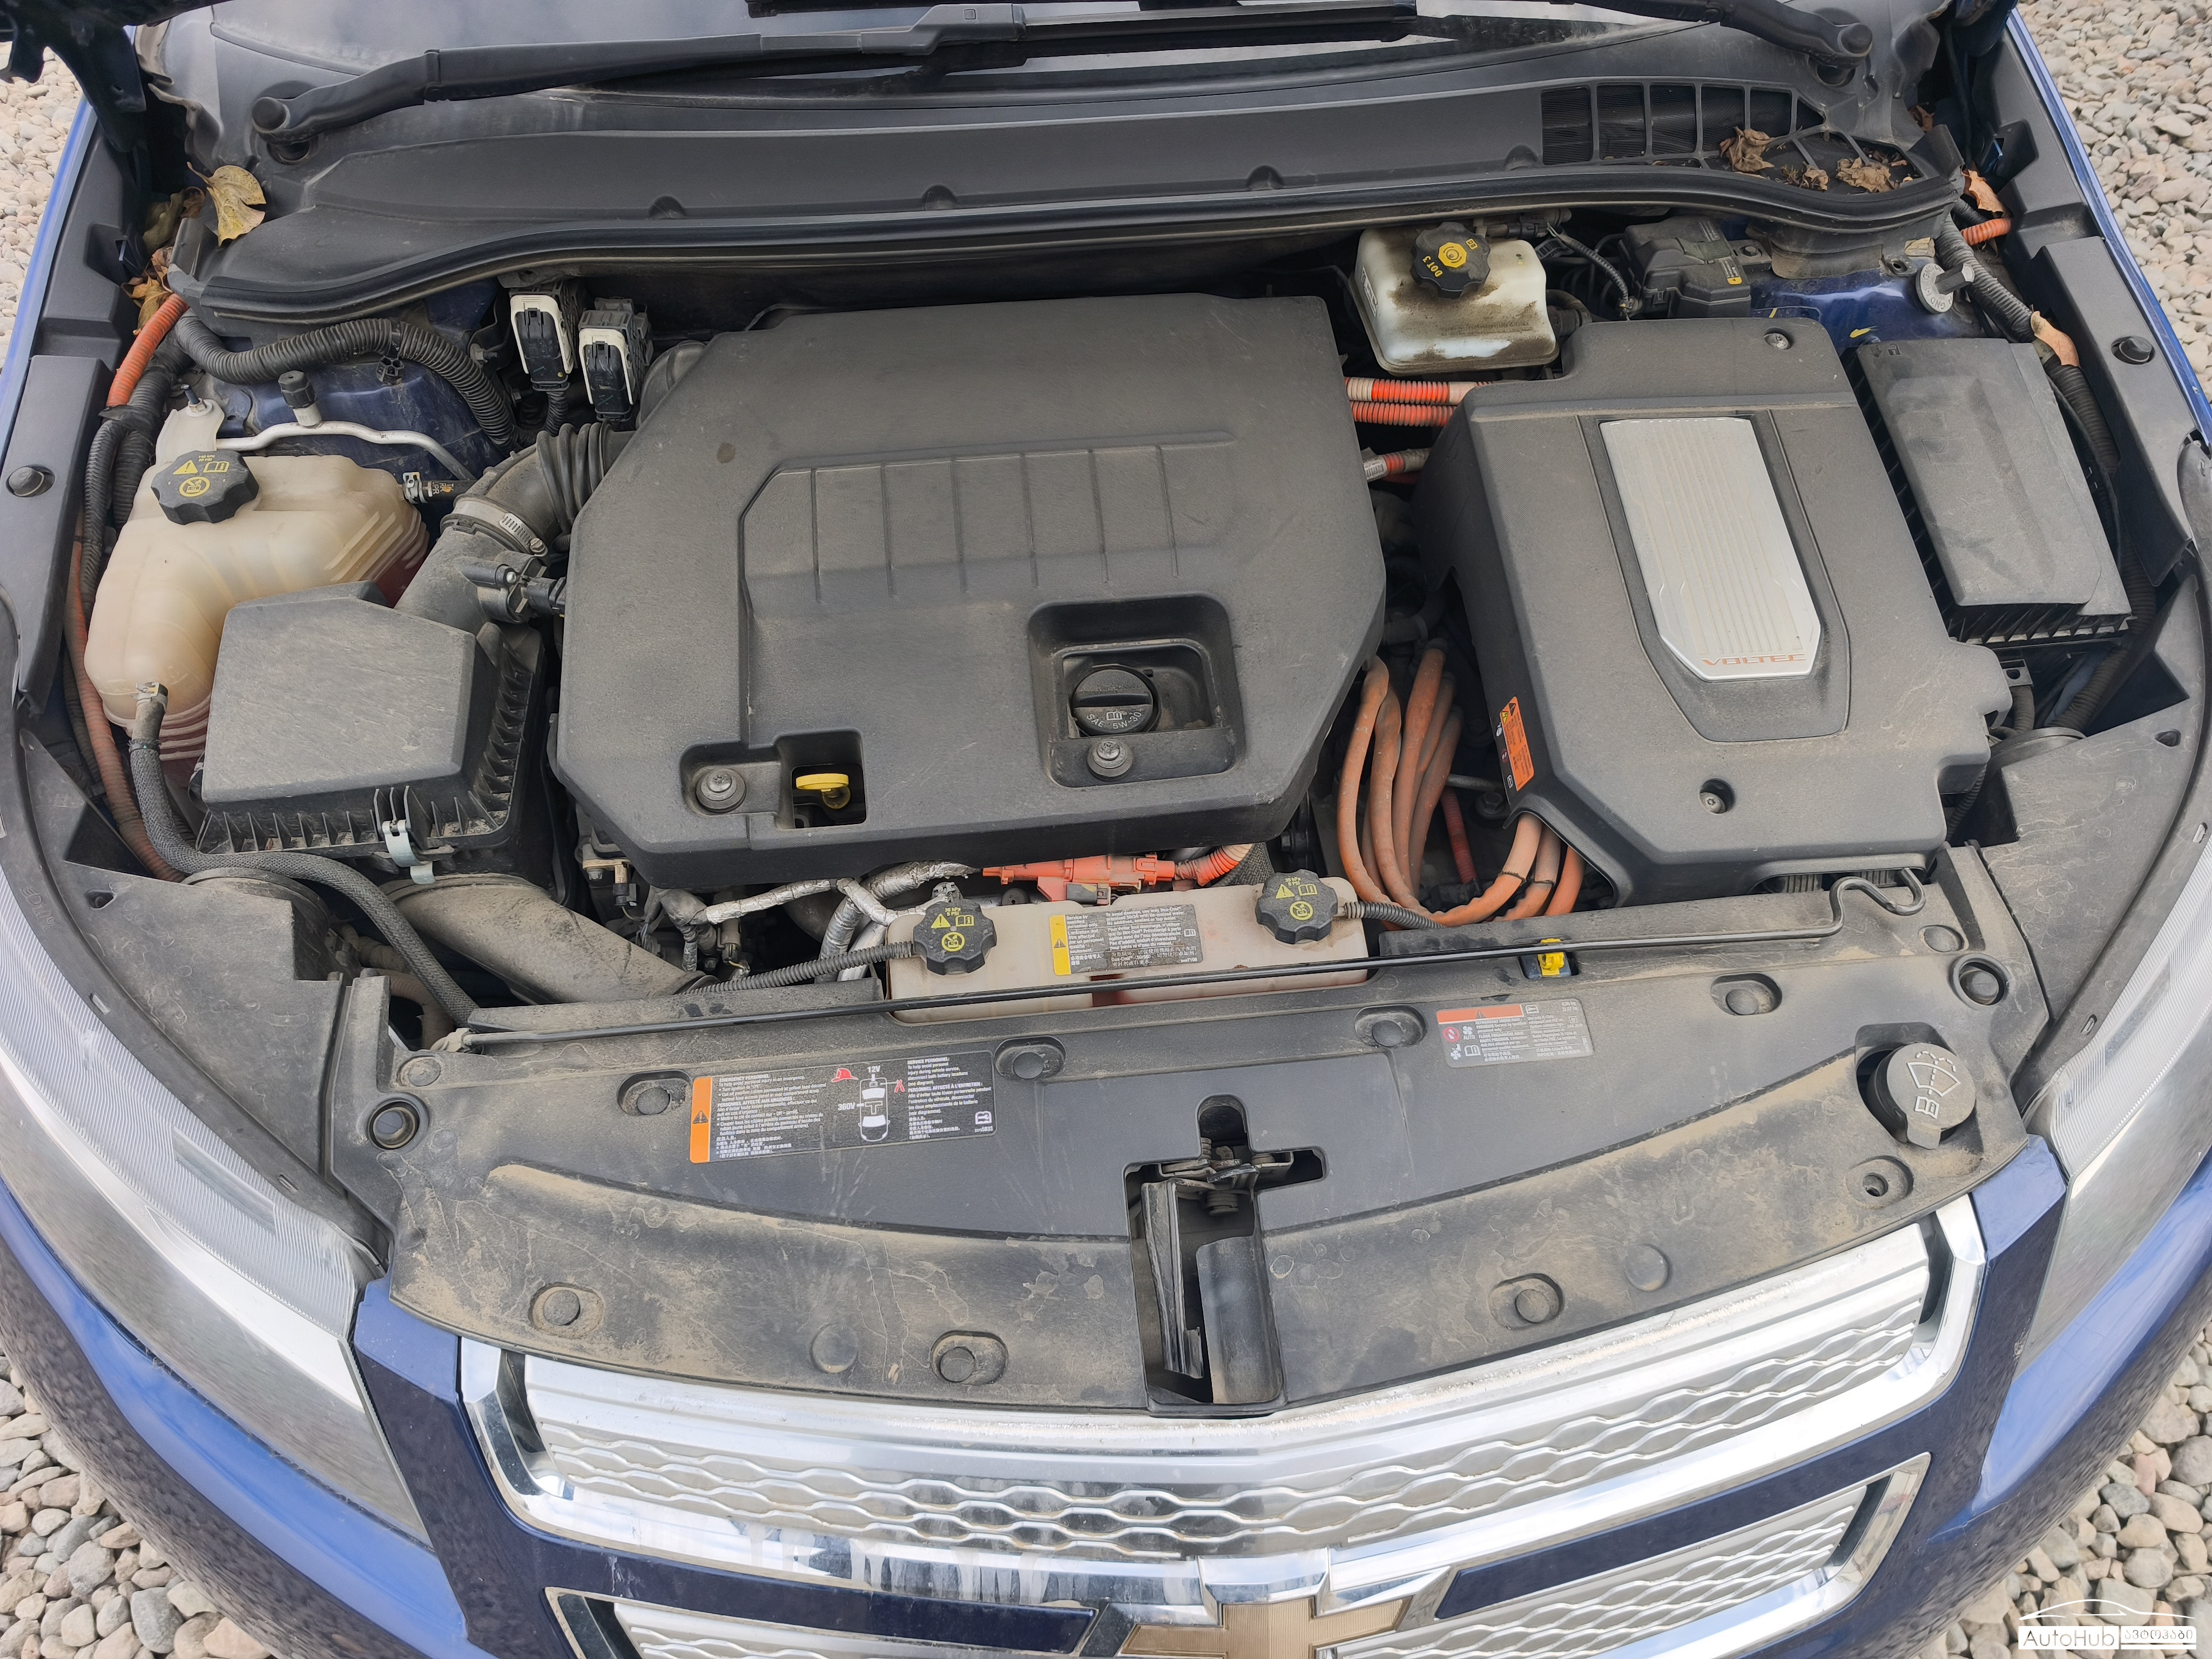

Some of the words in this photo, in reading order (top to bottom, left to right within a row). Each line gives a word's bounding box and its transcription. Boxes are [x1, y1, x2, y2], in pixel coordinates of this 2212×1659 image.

[1426, 262, 1443, 277] DOT
[1701, 653, 1806, 665] VOLTEC
[1086, 713, 1105, 728] SAE
[1112, 711, 1142, 729] 5W-30
